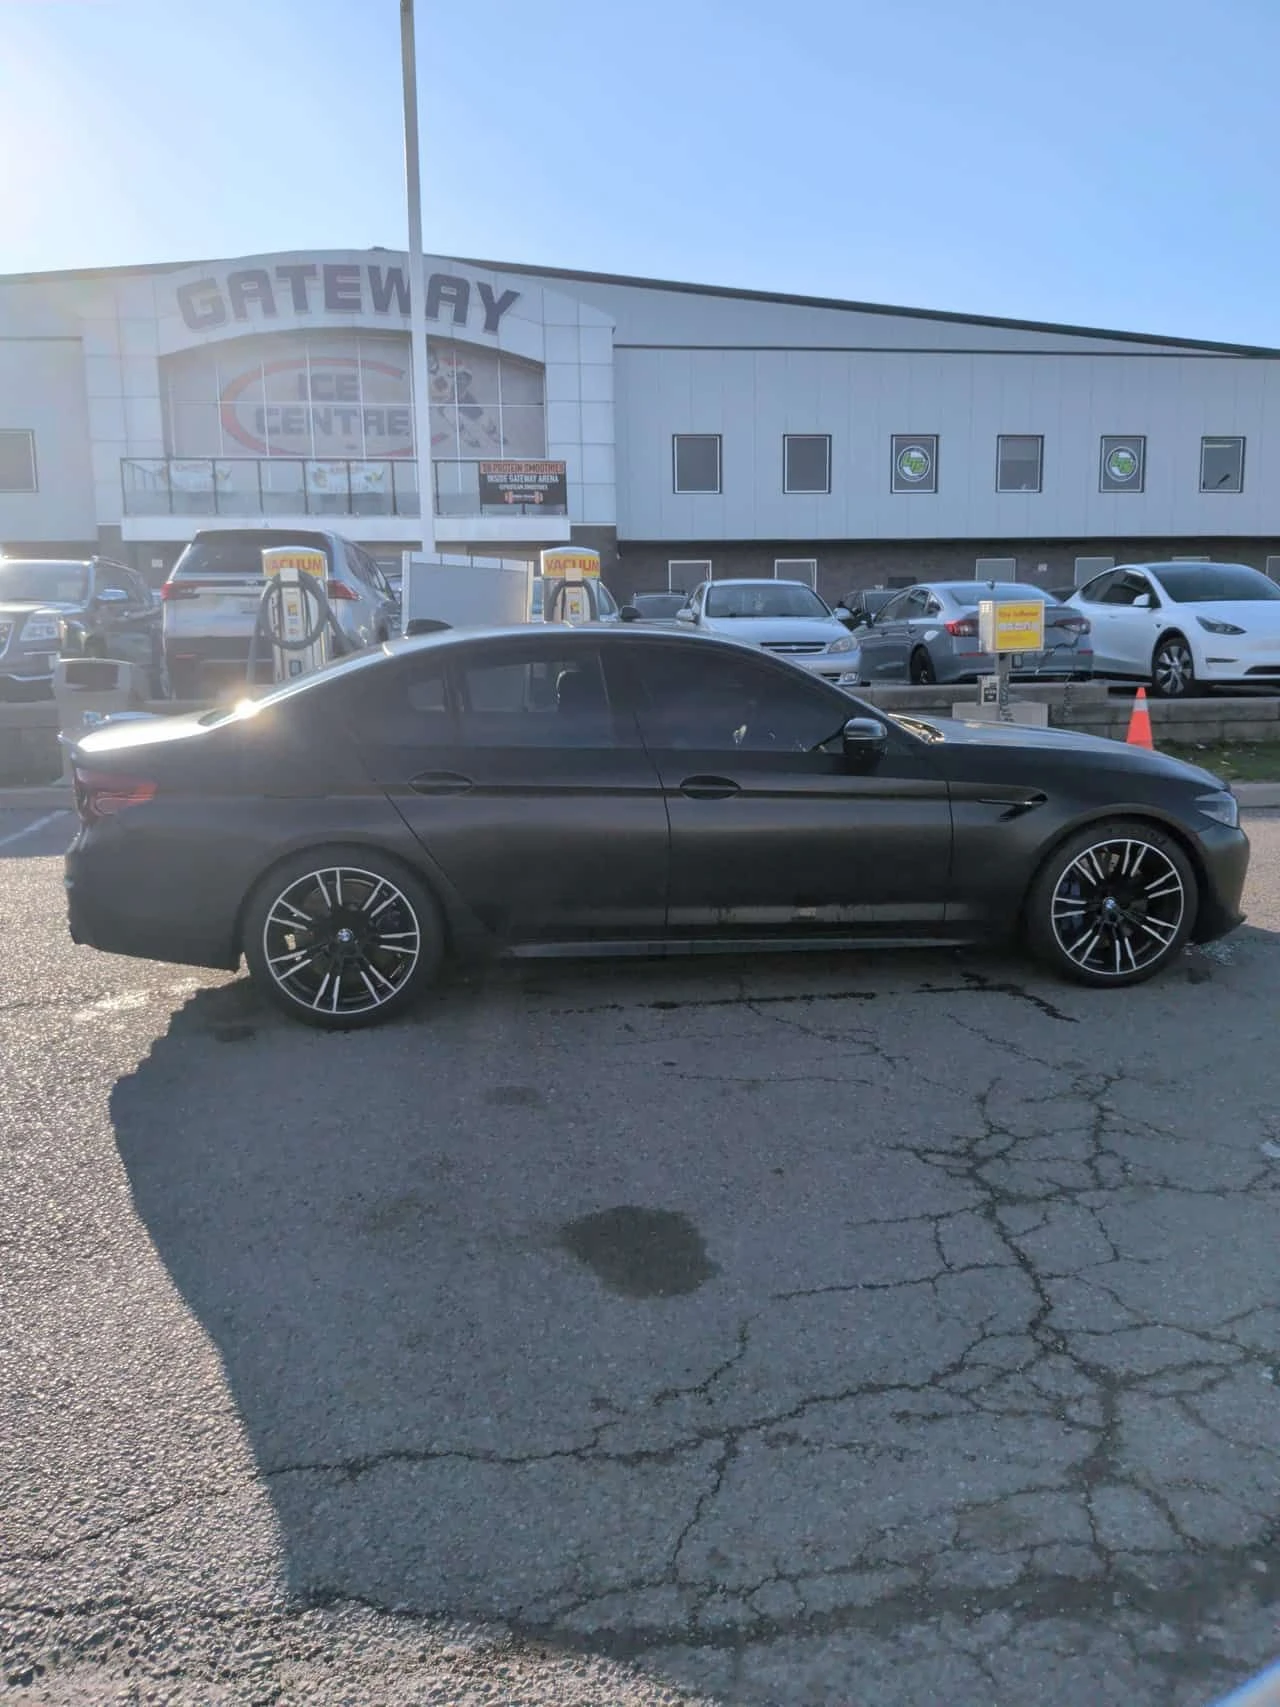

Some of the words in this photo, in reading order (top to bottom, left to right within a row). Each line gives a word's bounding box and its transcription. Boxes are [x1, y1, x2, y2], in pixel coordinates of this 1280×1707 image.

[177, 263, 521, 335] GATEWAY
[298, 373, 358, 401] ICE
[255, 407, 411, 437] CENTRE
[492, 463, 522, 473] PROTEIN
[524, 463, 564, 473] SMOOTHIES
[509, 474, 537, 483] GATEWAY
[538, 474, 559, 483] ARENA
[545, 559, 600, 571] VACUUM
